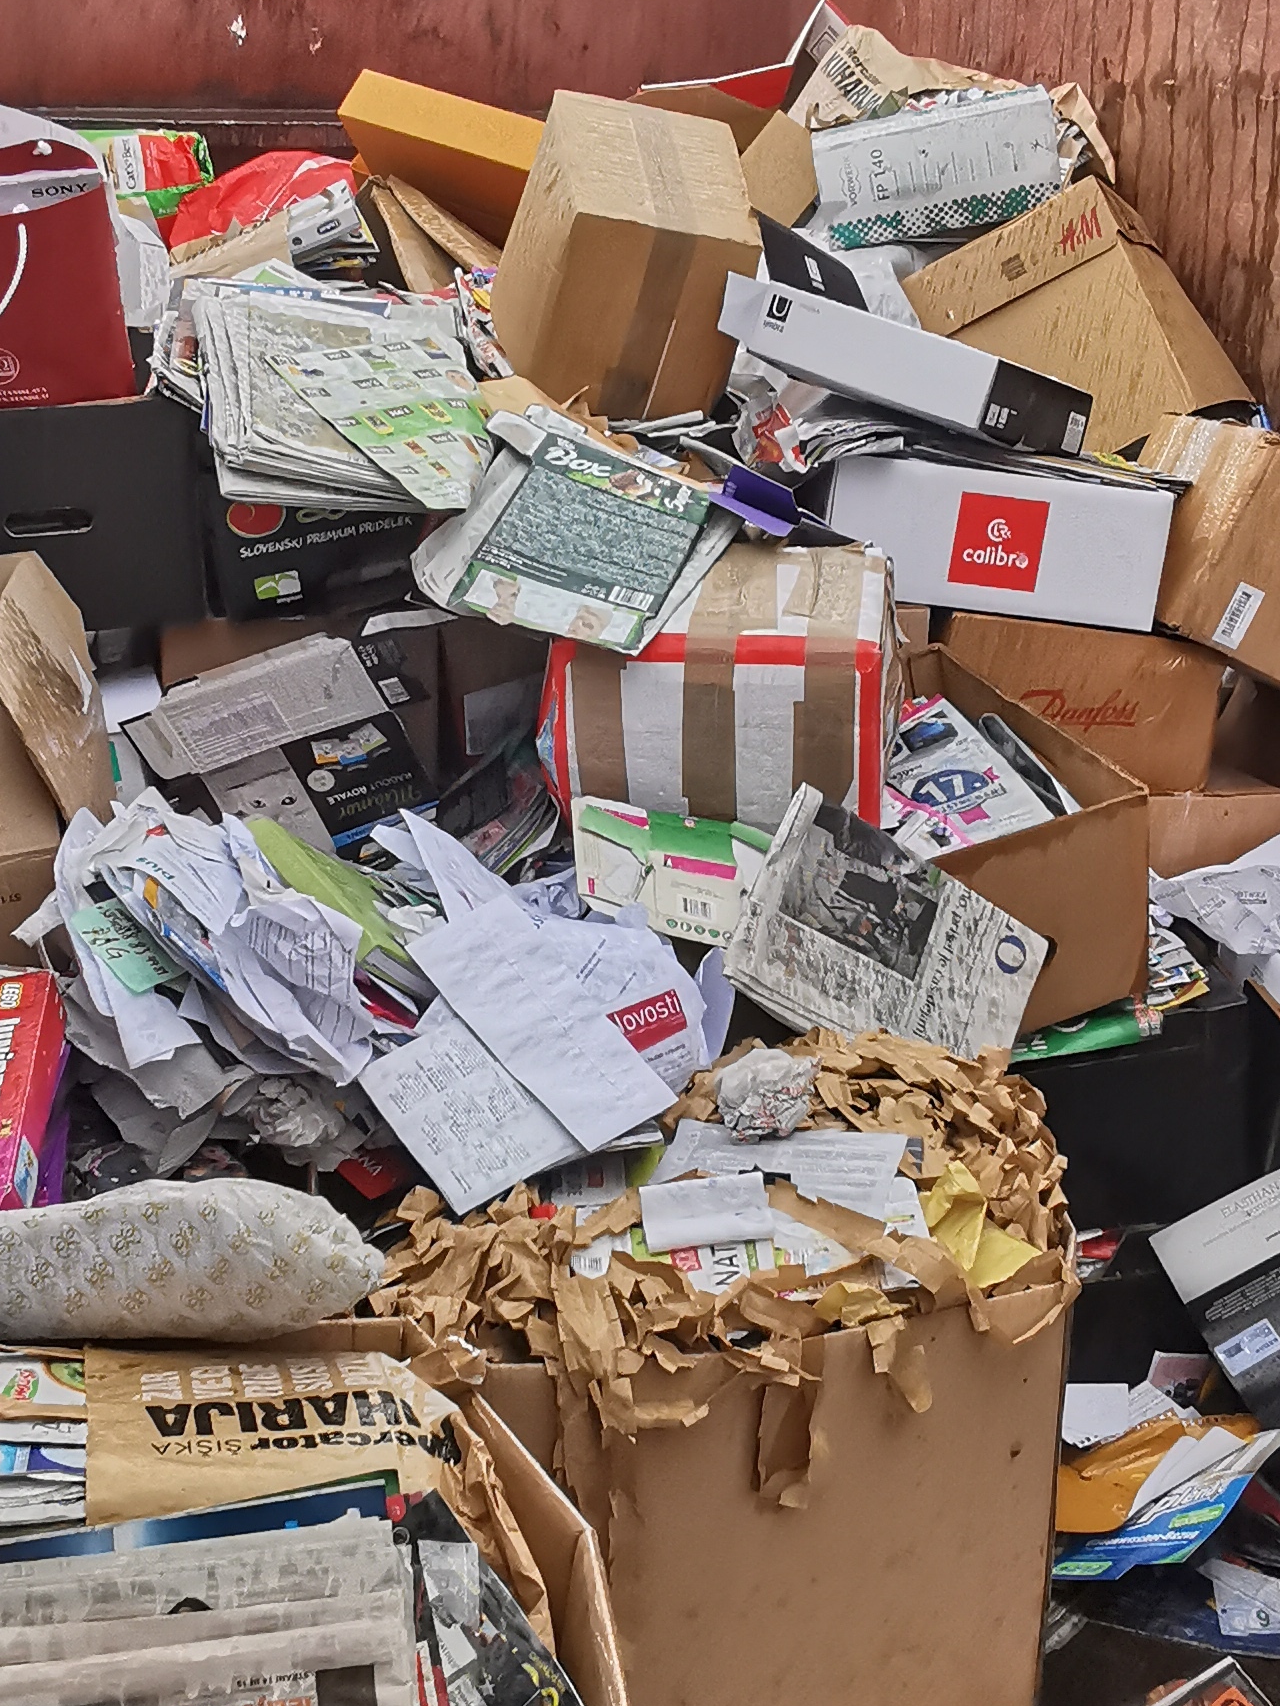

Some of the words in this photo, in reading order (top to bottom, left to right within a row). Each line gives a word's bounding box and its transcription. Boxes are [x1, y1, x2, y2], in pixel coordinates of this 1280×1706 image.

[31, 182, 89, 199] SONY
[239, 536, 304, 559] SLOVENSKI
[305, 524, 358, 546] PREMIUM
[358, 514, 414, 536] PRIDELEK
[962, 544, 1029, 570] calibro
[325, 784, 368, 806] ROYALE
[154, 1436, 243, 1459] ŠIŠKA
[251, 1408, 464, 1467] Mercator
